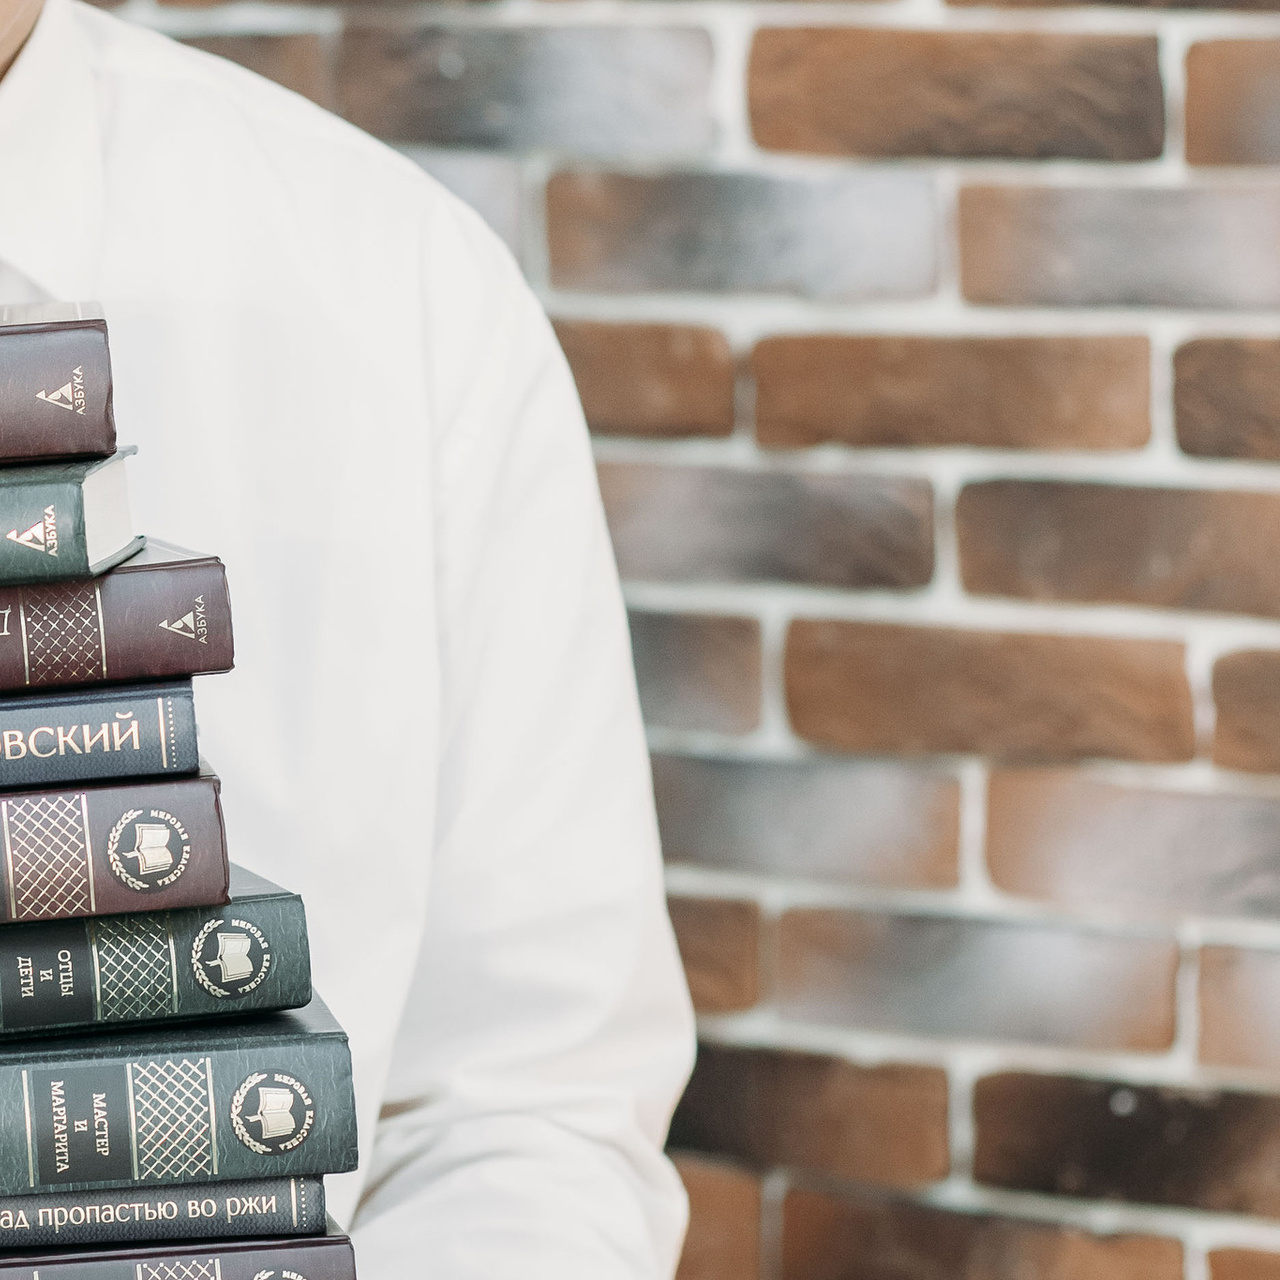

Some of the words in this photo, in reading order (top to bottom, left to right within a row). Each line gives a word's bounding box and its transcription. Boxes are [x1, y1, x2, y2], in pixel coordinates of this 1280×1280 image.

[73, 365, 87, 415] АЗБУКА
[44, 504, 58, 557] АЗБУКА
[196, 594, 208, 645] АЗБУКА
[17, 956, 35, 997] ДЕТИ
[40, 968, 53, 981] И
[57, 949, 74, 996] ОТЦЫ
[50, 1080, 70, 1174] МАРГАРИТА
[74, 1119, 88, 1133] И
[92, 1093, 110, 1157] МАСТЕР
[38, 1196, 178, 1233] пропастью
[187, 1197, 217, 1219] во
[226, 1195, 276, 1224] ржи
